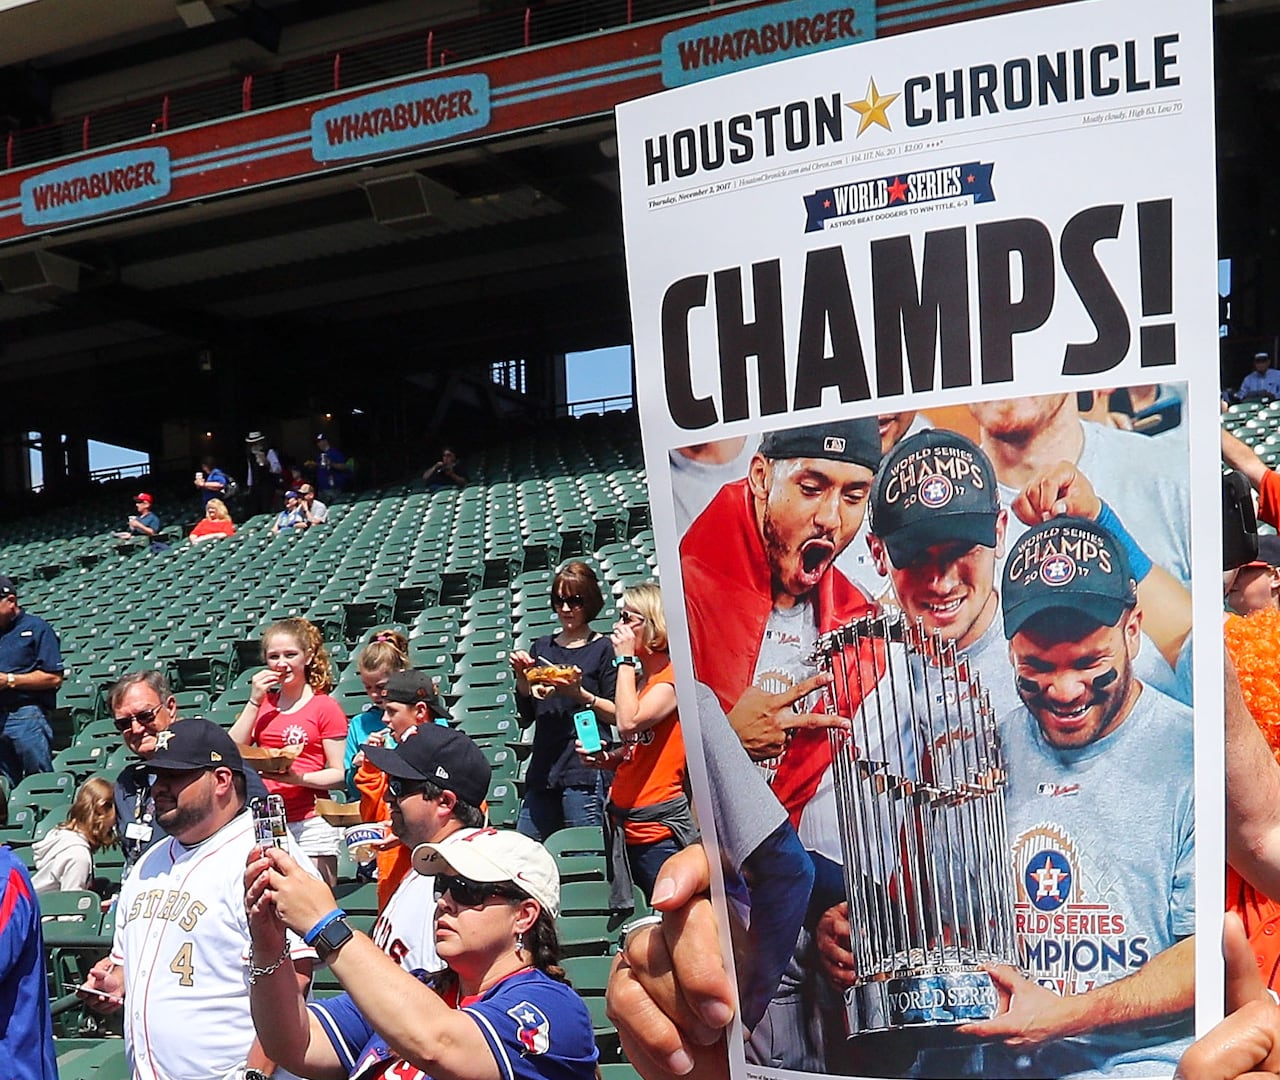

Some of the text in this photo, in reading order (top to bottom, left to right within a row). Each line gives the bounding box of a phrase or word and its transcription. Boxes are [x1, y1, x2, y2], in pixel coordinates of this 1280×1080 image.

[677, 7, 860, 71] WHATABURGER
[325, 89, 477, 146] WHATABURGER
[645, 33, 1180, 186] HOUSTON CHRONICLE
[32, 161, 158, 211] WHATABURGER
[679, 187, 707, 201] November
[716, 182, 731, 192] 2017
[833, 166, 962, 216] WORLD SERIES
[830, 219, 856, 229] ASTROS
[857, 215, 874, 225] BEAT
[875, 210, 908, 221] DODGERS
[920, 205, 934, 213] WIN
[934, 201, 956, 212] TITLE,
[661, 198, 1176, 430] CHAMPS!
[885, 457, 985, 505] CHAMPS
[890, 446, 974, 476] WORLD SERIES
[903, 493, 917, 509] 20
[954, 484, 966, 497] 17
[1009, 536, 1112, 581] CHAMPS
[1017, 526, 1104, 554] WORLD SERIES
[1024, 570, 1038, 585] 20
[1077, 565, 1090, 578] 17
[127, 888, 207, 932] STROS
[1015, 914, 1125, 935] RLD SERIES
[169, 942, 194, 987] 4
[1021, 937, 1149, 972] MPIONS
[889, 988, 945, 1013] WORLD
